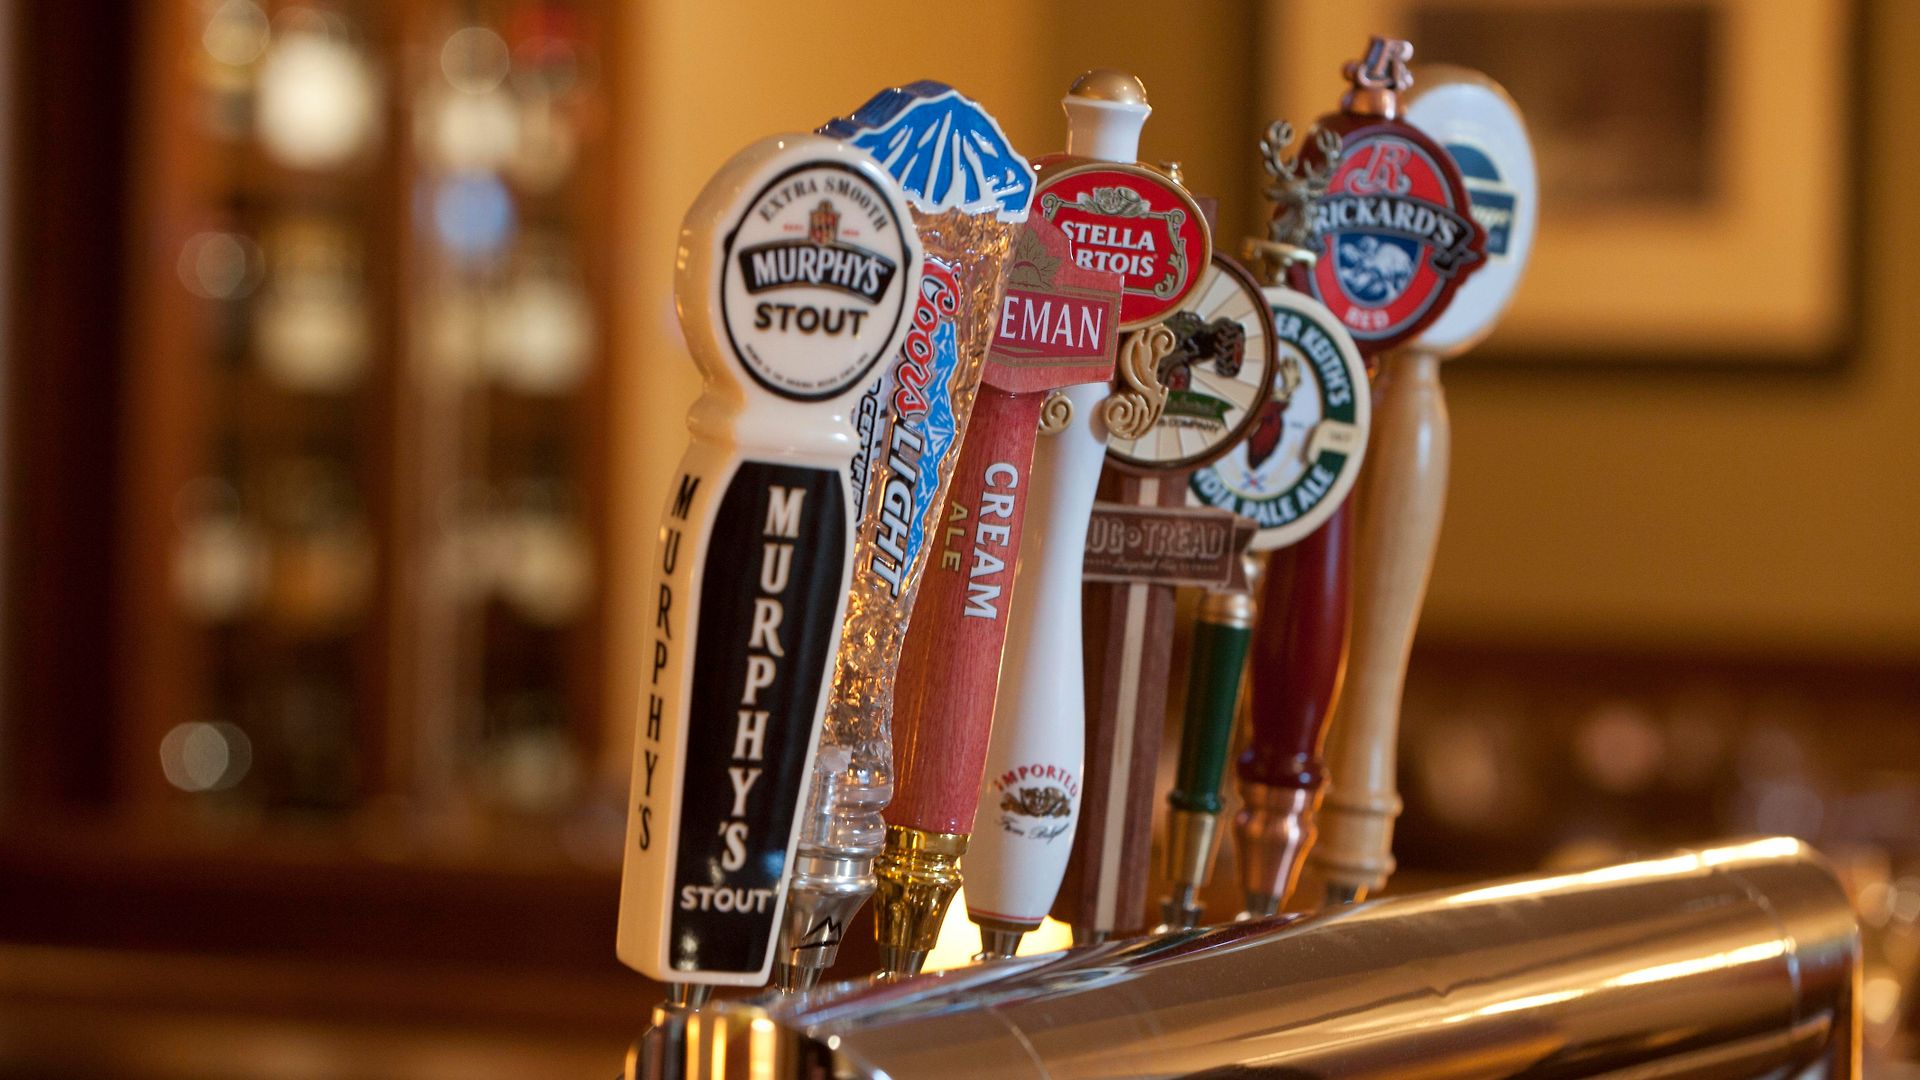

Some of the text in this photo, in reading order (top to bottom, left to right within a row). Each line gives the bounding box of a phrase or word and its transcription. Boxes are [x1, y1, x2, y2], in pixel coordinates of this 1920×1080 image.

[758, 175, 889, 233] EXTRA SMOOTH
[1061, 220, 1156, 251] STELLA
[1075, 249, 1155, 278] RTOIS
[754, 301, 869, 336] STOUT
[896, 258, 963, 419] Coors
[1000, 295, 1103, 350] EMAN
[1344, 305, 1389, 330] RED
[870, 421, 925, 599] LIGHT
[1241, 499, 1298, 527] PALE
[1296, 463, 1334, 512] ALE
[941, 501, 969, 573] ALE
[963, 462, 1019, 620] CREAM
[638, 474, 701, 851] MURPHY'S
[718, 485, 807, 872] MURPHY'S
[680, 885, 773, 914] STOUT
